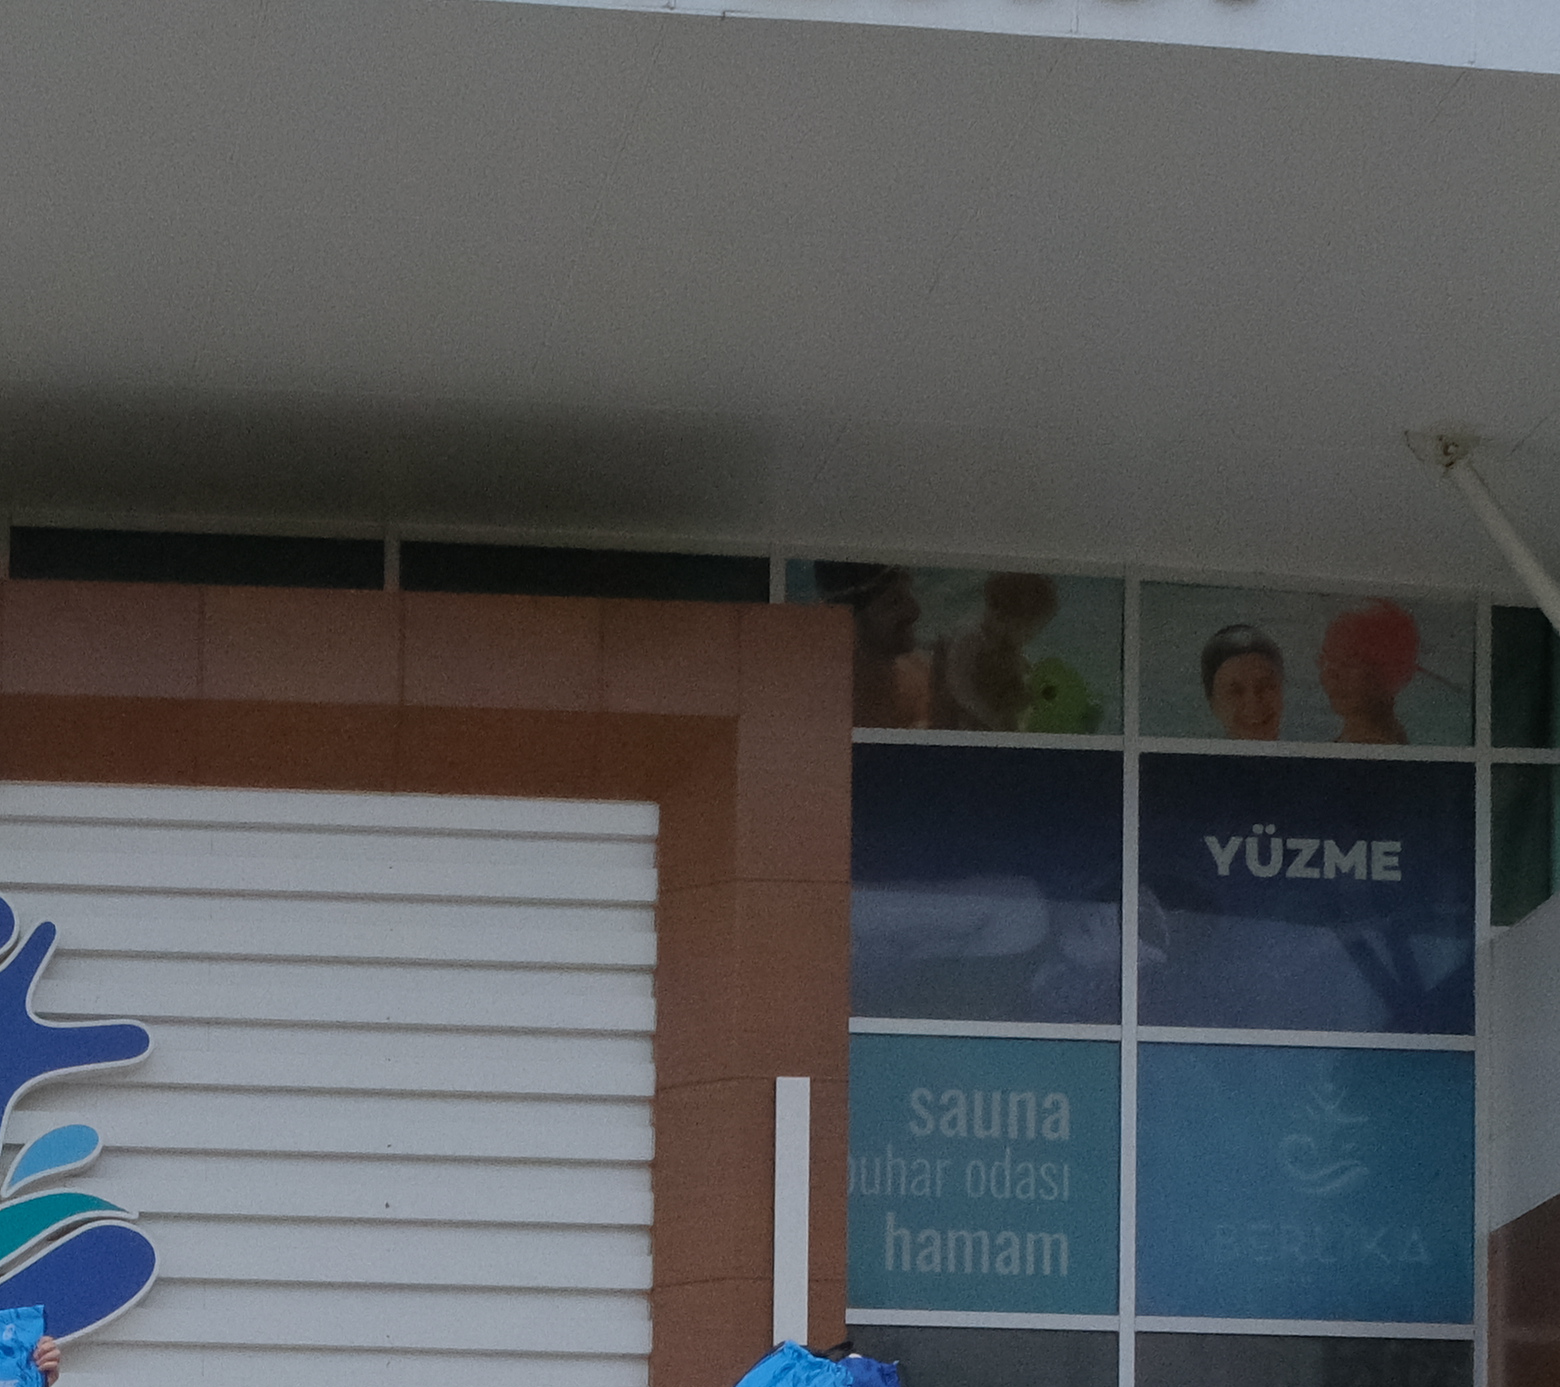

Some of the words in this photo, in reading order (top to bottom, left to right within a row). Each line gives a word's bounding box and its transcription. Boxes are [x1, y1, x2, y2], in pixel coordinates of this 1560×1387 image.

[1203, 823, 1403, 882] YÜZME
[908, 1087, 1071, 1142] sauna
[964, 1146, 1071, 1201] odası
[884, 1211, 1069, 1277] hamam
